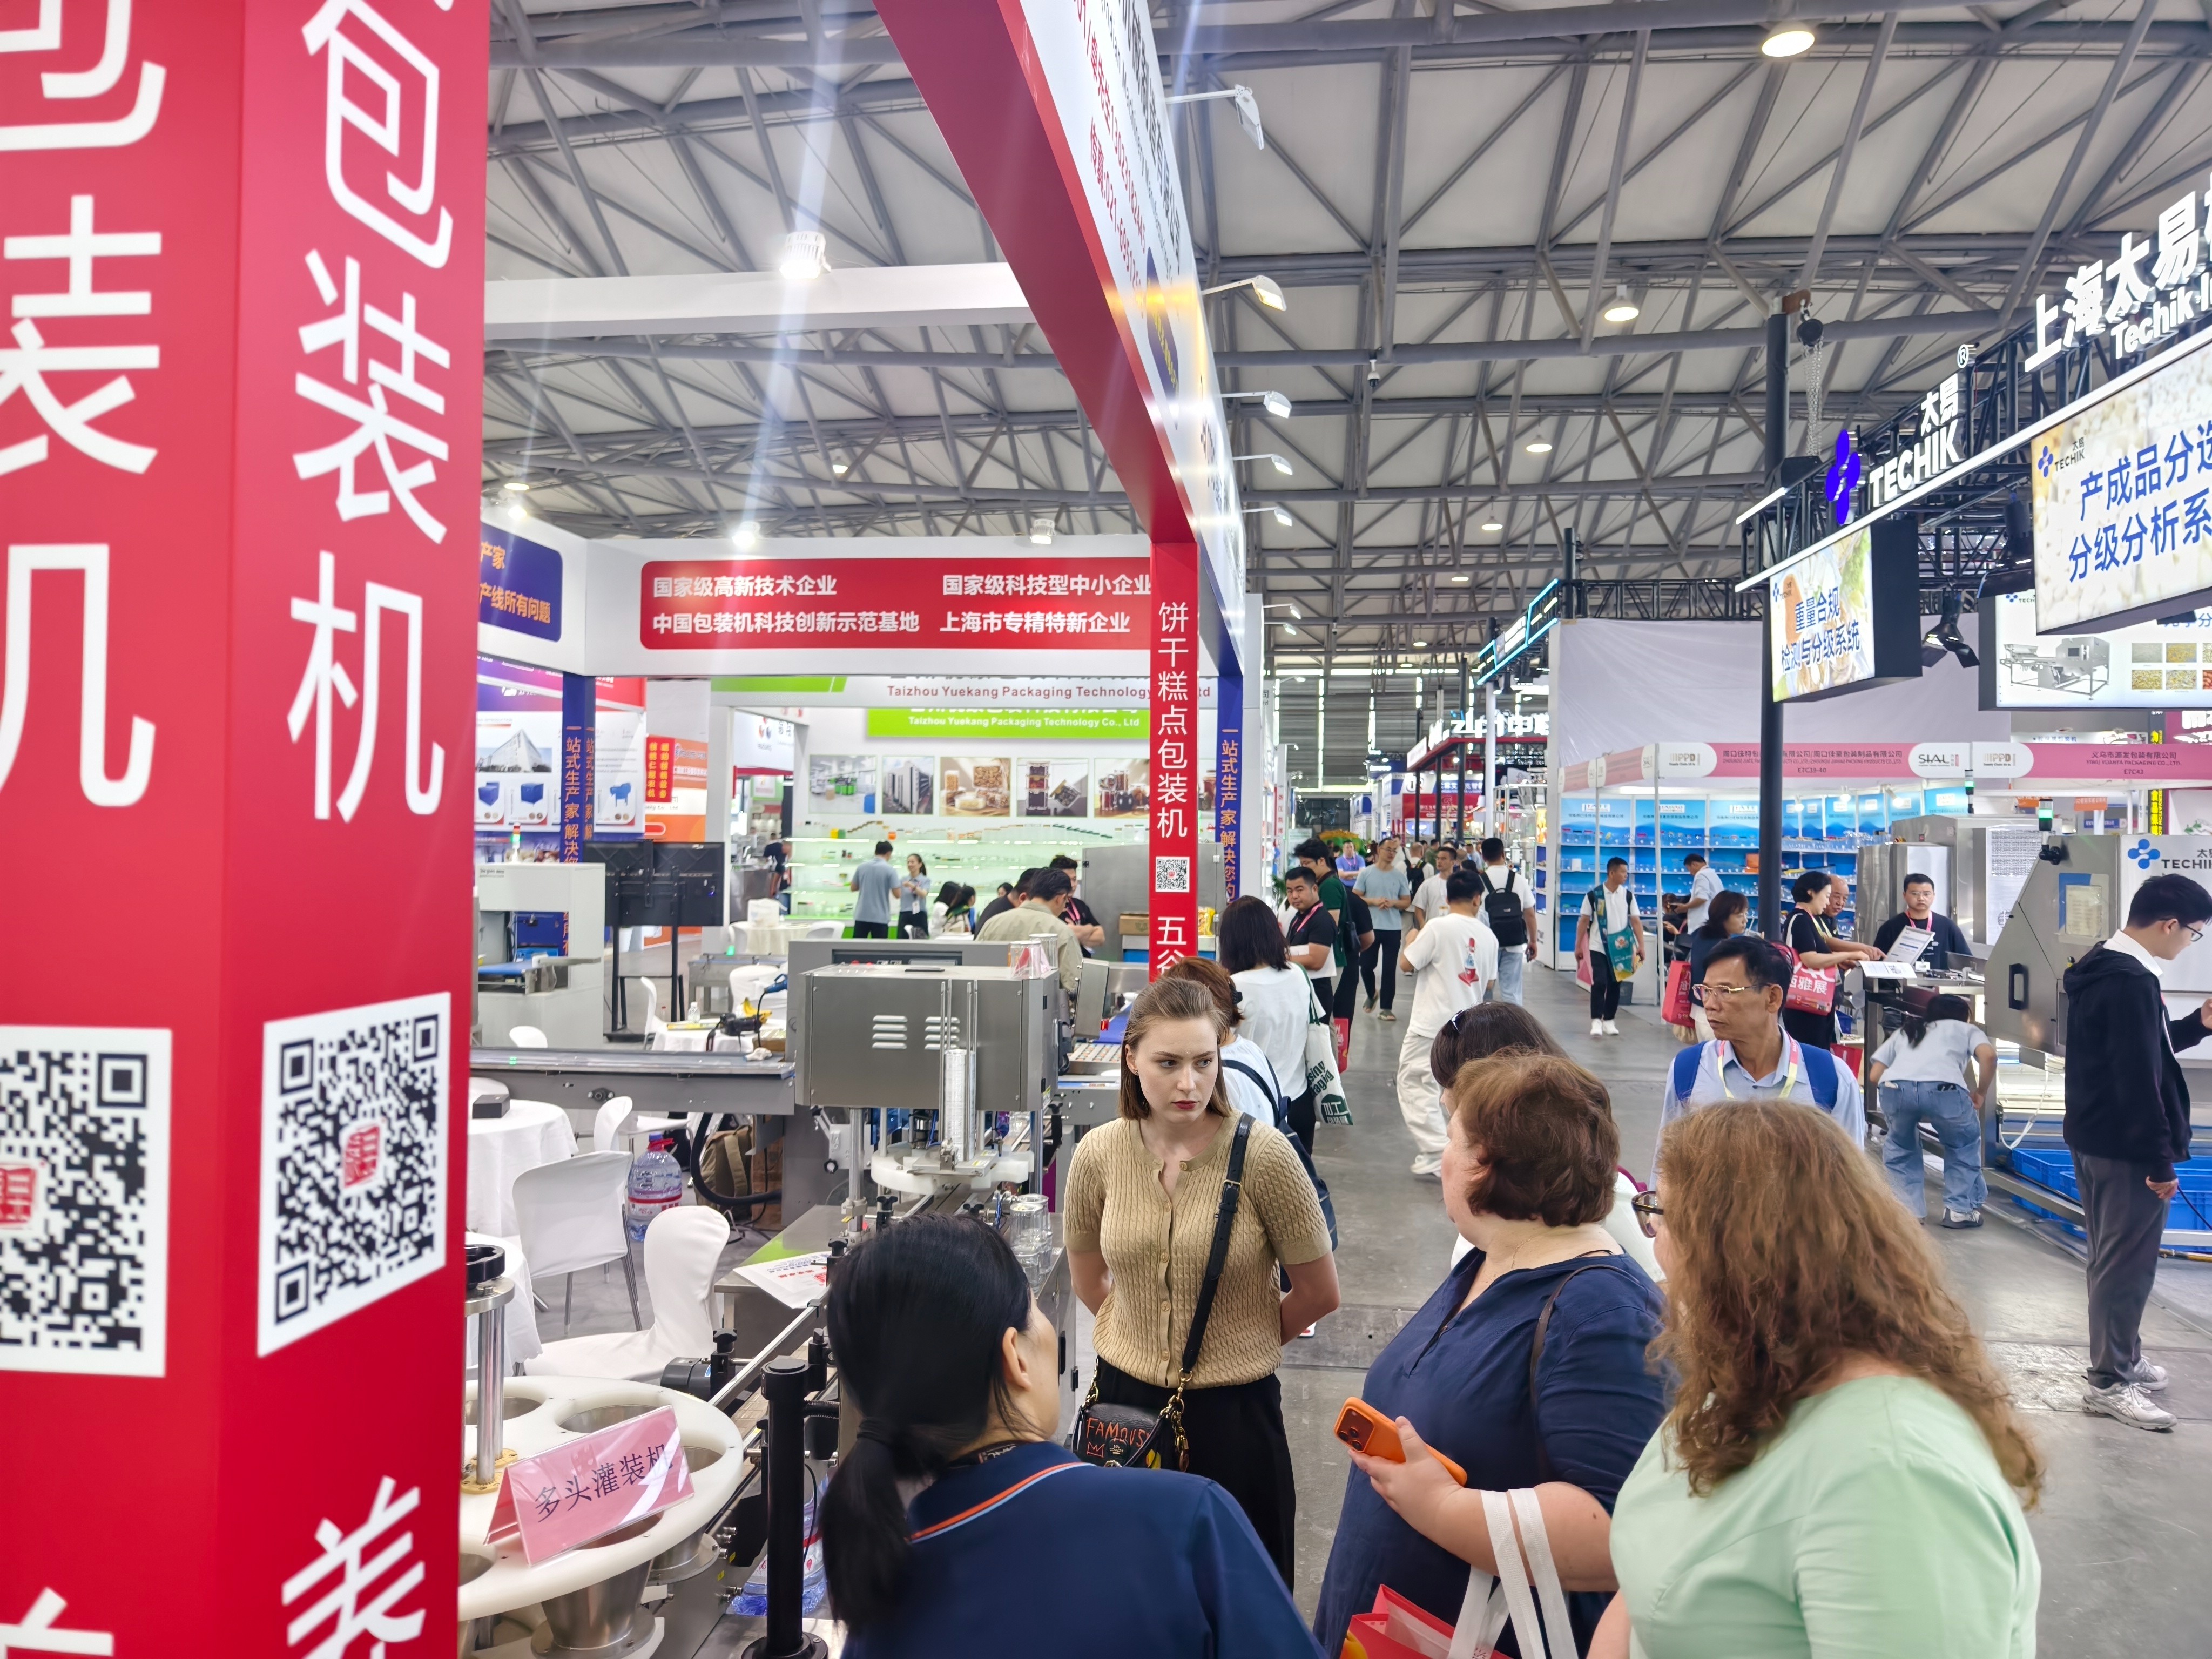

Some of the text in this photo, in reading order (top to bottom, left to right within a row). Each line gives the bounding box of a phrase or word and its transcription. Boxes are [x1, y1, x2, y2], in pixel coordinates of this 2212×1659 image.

[2110, 272, 2212, 360] Techik I
[287, 0, 454, 823] 包装机
[1920, 373, 1959, 437] 太易
[1869, 418, 1960, 508] TECHIK
[2054, 449, 2085, 473] TECHIK
[2068, 487, 2212, 583] 分级分析系
[652, 574, 1151, 598] 国家级高新技术企业 国家级科技型中小企业
[1795, 586, 1840, 632] 重量合规
[652, 610, 1130, 635] 中国包装机科技创新示范基地 上海市专精特新企业
[1781, 619, 1861, 672] 检测与分级系统
[887, 685, 938, 696] Taizhou
[942, 686, 999, 699] Yuekang
[1002, 686, 1072, 699] Packaging
[1198, 686, 1211, 697] td
[908, 716, 946, 725] Taizhou
[948, 717, 989, 727] Yuekang
[991, 717, 1042, 727] Packaging
[1044, 718, 1099, 728] Technology
[1123, 718, 1140, 726] Ltd
[1157, 601, 1189, 839] 饼干糕点包装机
[1918, 754, 1950, 764] SIAL
[1086, 1417, 1146, 1448] FAMOUS
[535, 1444, 673, 1523] 多头灌装机
